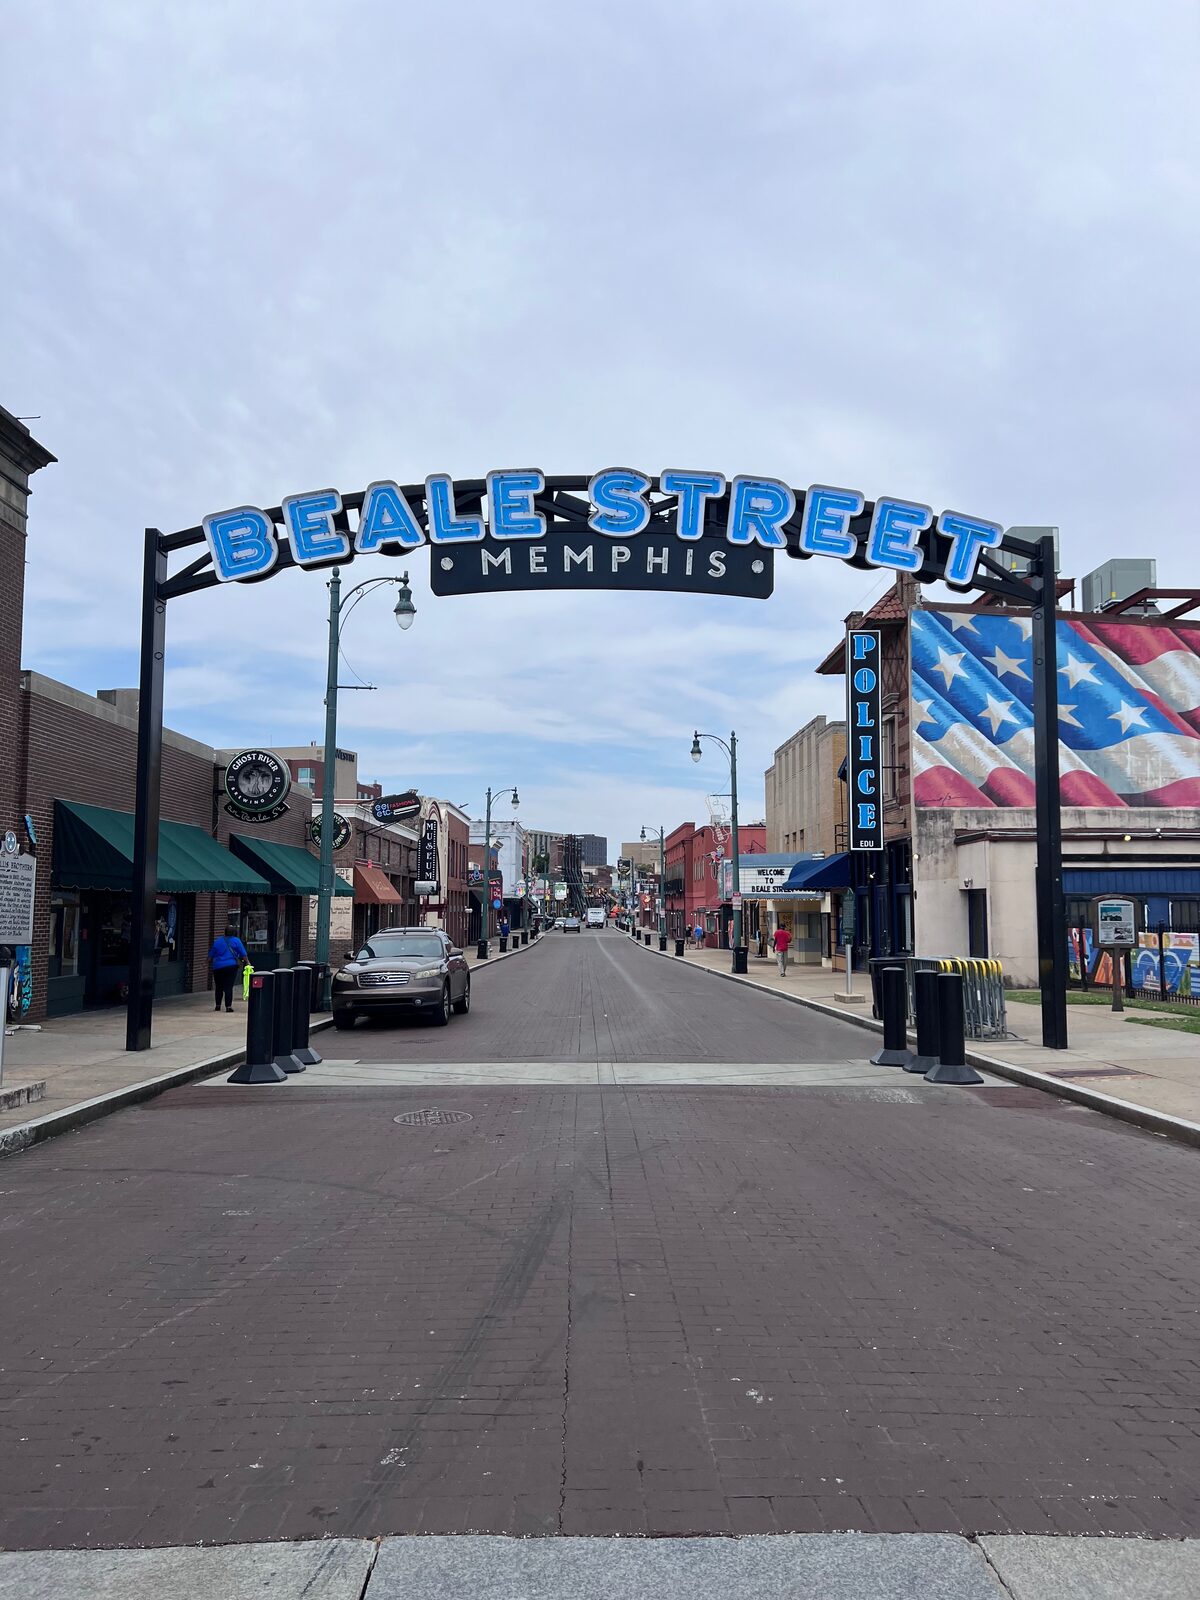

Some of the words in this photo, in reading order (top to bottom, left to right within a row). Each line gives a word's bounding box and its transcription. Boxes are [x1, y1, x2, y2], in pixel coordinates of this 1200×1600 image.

[201, 468, 547, 583] BEALE
[587, 466, 1004, 587] STREET
[480, 545, 728, 578] MEMPHIS
[853, 634, 876, 829] POLICE
[232, 753, 257, 771] GHOST
[257, 753, 279, 772] RIVER
[231, 786, 265, 805] BREWING
[424, 821, 434, 880] MUSEUM
[859, 839, 874, 848] EDU
